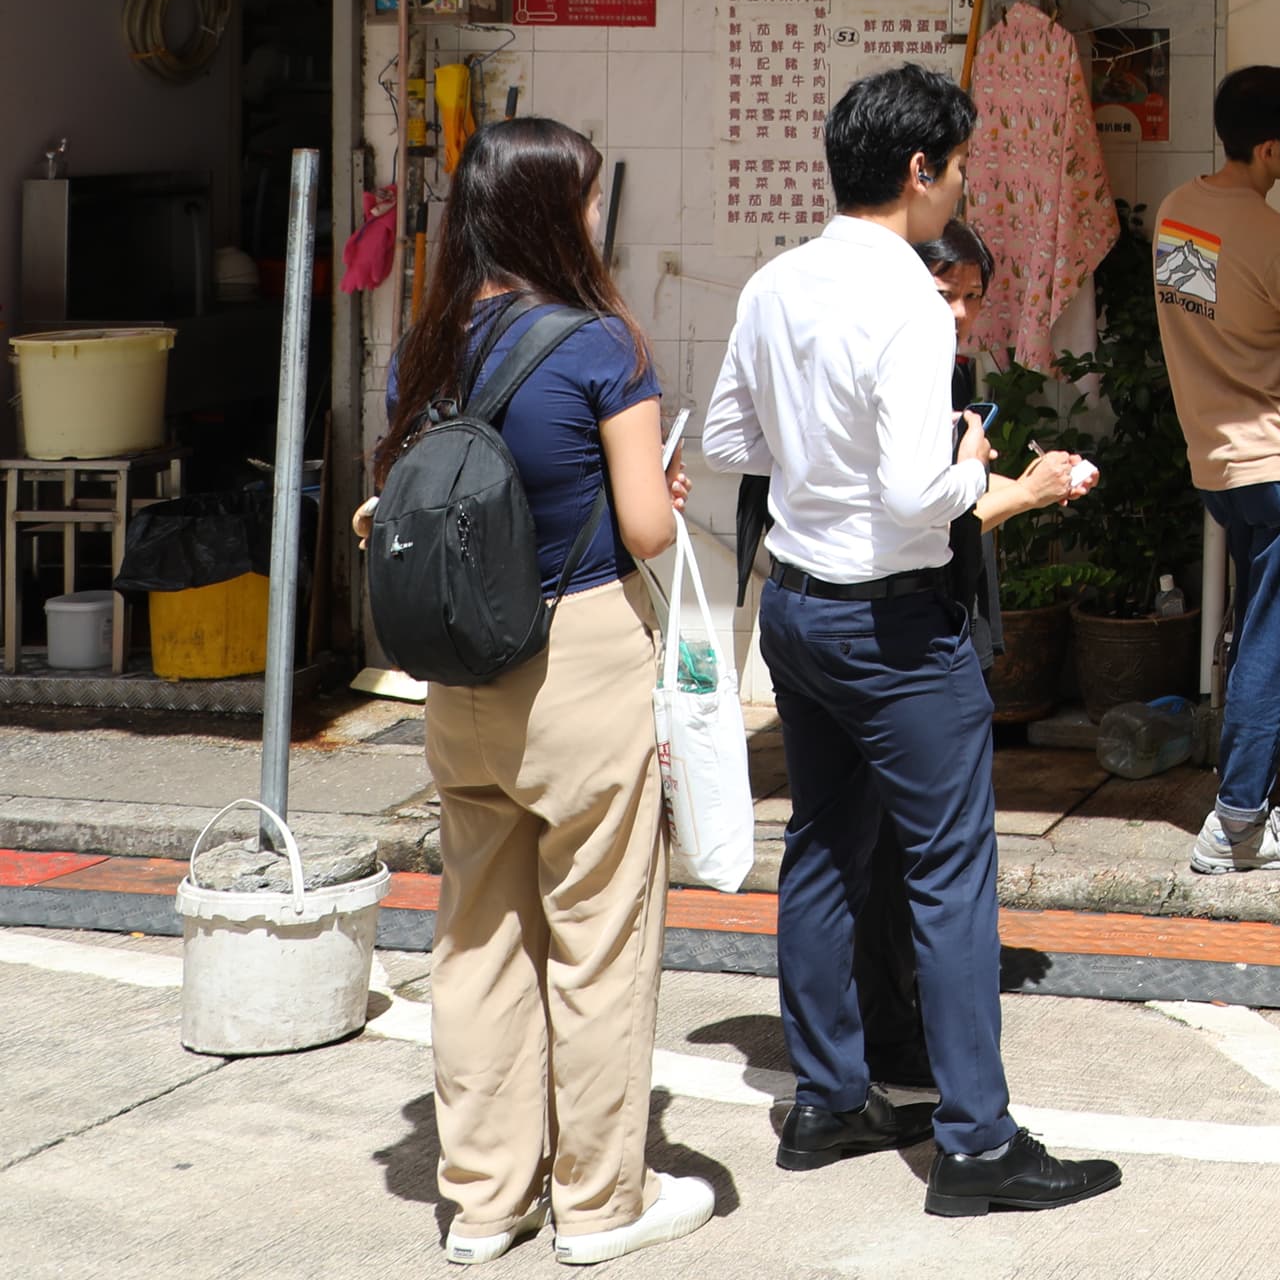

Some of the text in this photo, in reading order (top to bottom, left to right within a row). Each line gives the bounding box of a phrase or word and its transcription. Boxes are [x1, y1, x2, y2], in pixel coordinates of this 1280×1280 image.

[729, 23, 826, 36] 鮮茄豬扒
[837, 31, 857, 43] 51
[729, 40, 826, 53] 鮮茄鮮牛肉
[729, 57, 826, 70] 科記豬扒
[729, 74, 826, 88] 青菜鮮牛肉
[729, 91, 826, 104] 青菜北菇
[729, 125, 826, 139] 青菜豬扒
